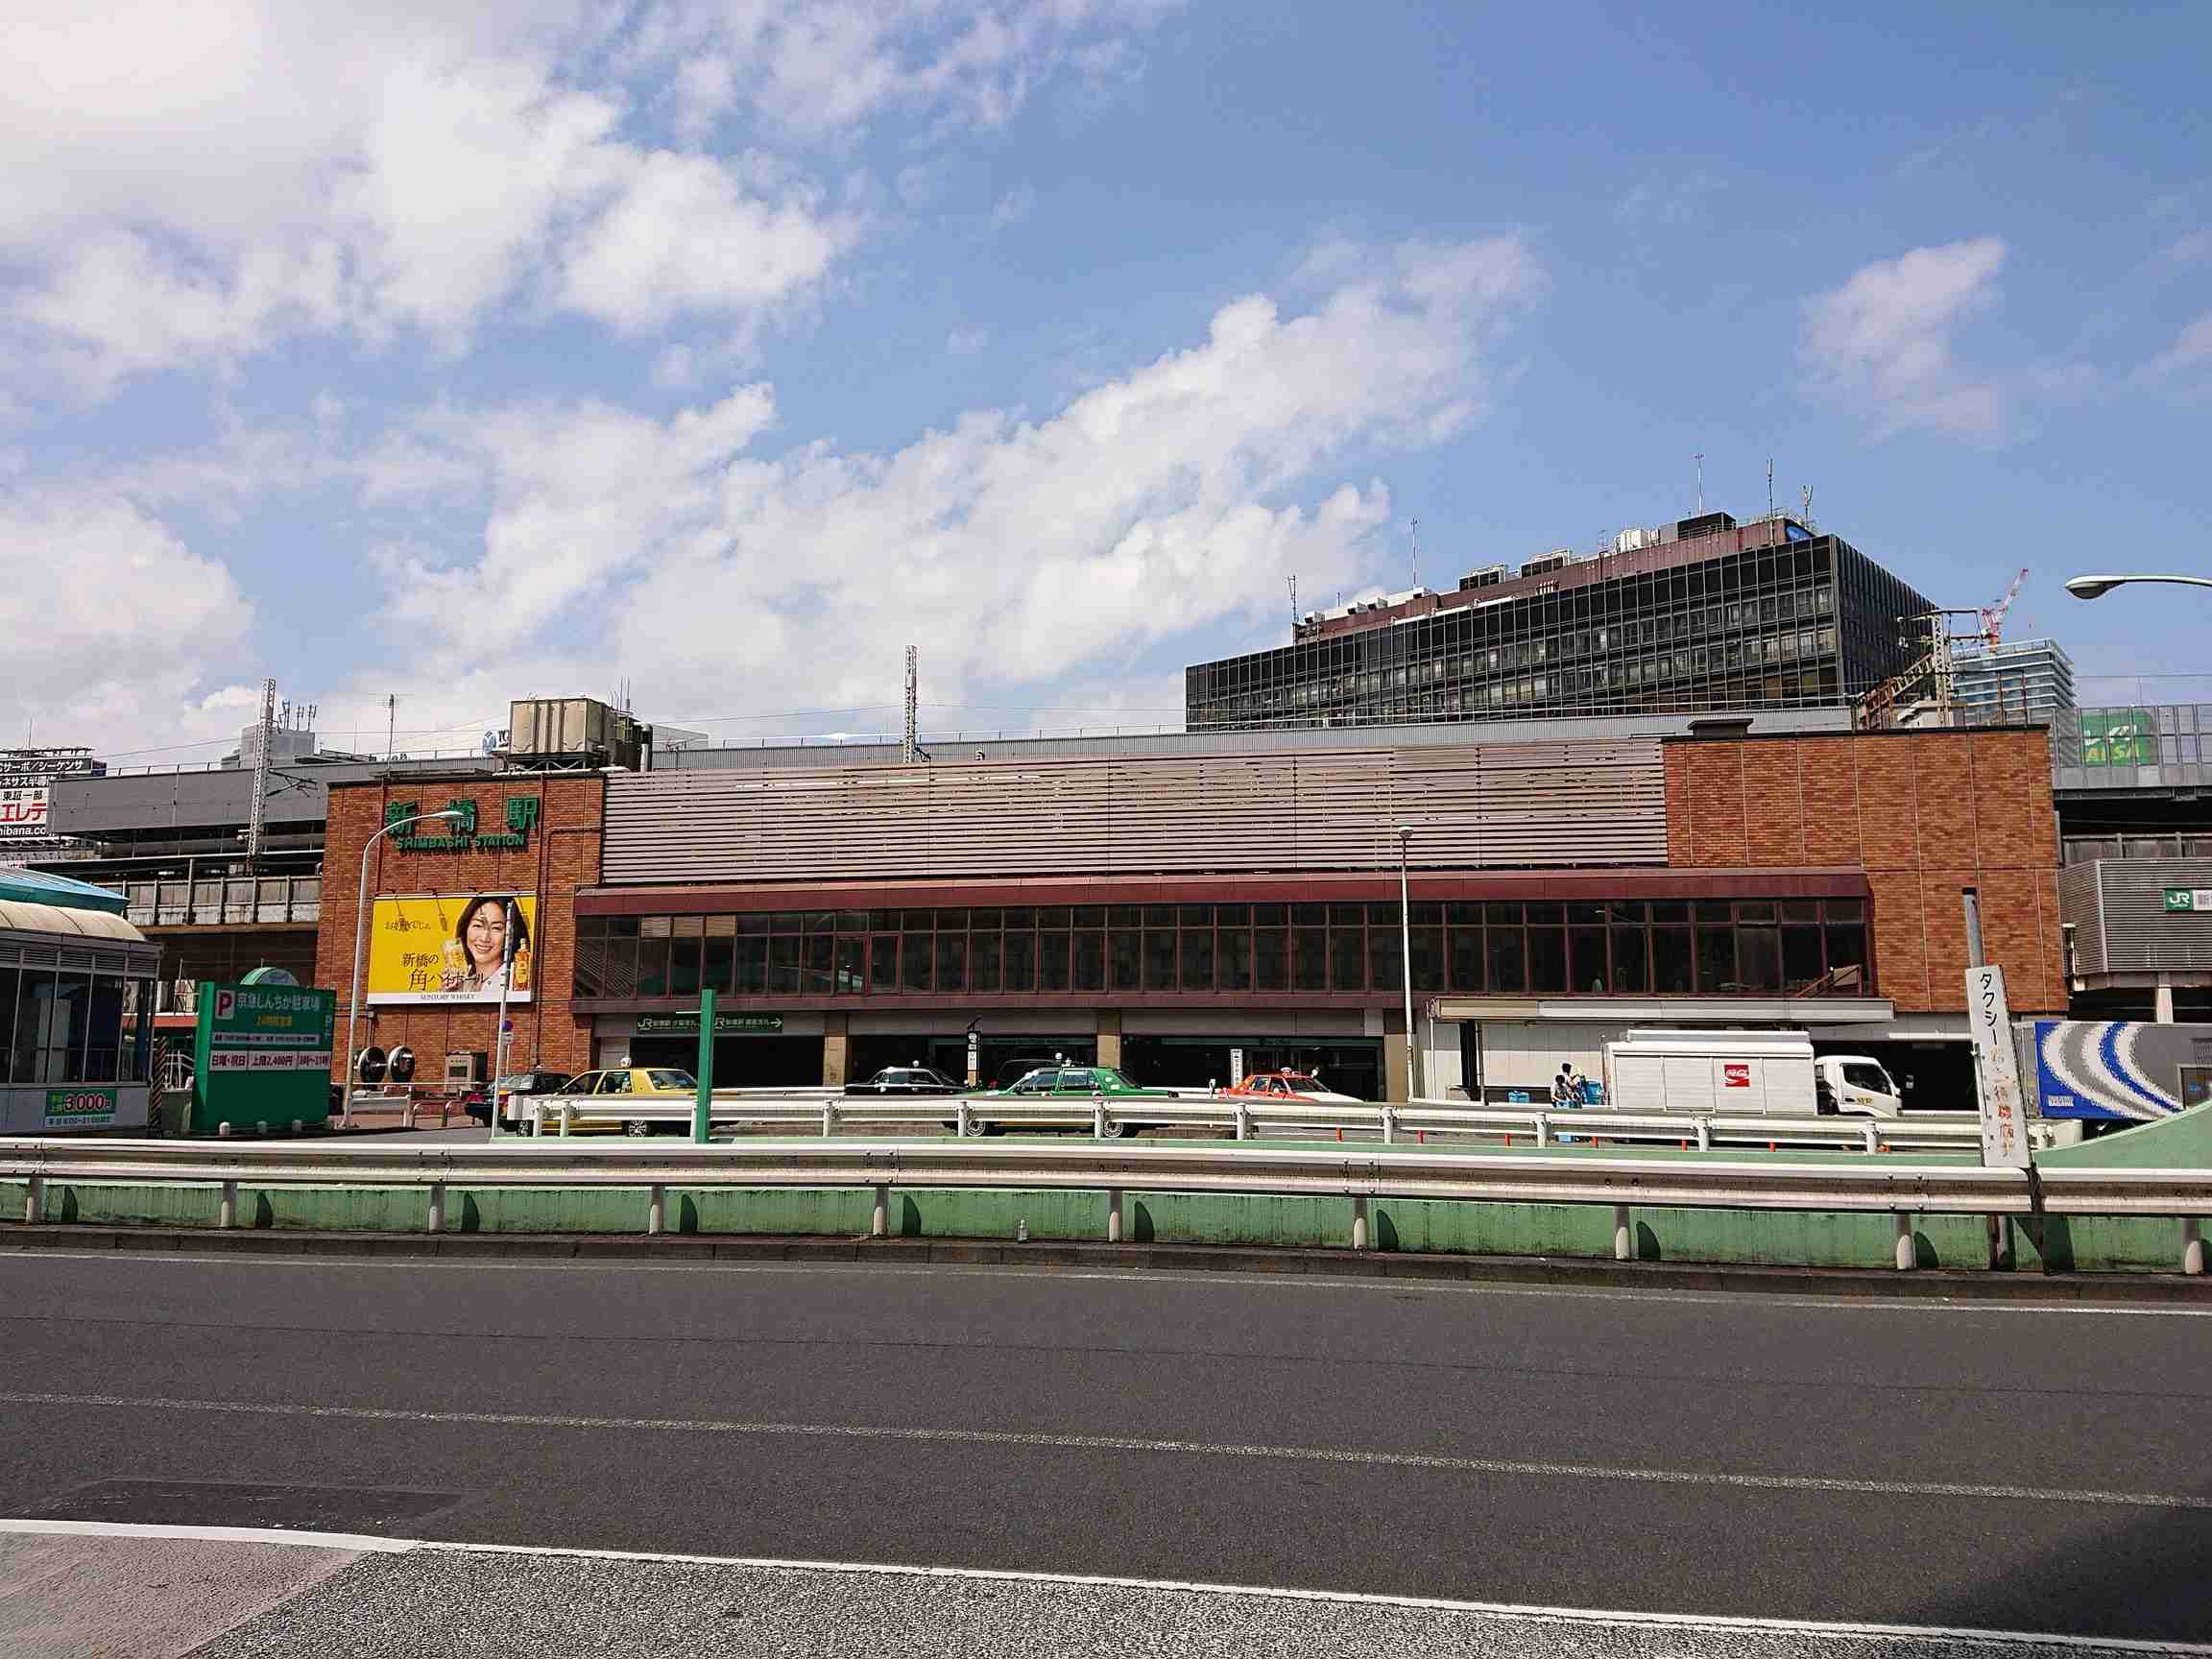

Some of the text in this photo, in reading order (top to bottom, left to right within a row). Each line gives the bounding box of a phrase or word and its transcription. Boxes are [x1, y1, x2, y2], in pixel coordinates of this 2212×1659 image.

[397, 834, 525, 850] SHIMBASHI STATION
[2169, 892, 2190, 904] JR
[401, 952, 439, 968] 新橋の
[218, 992, 232, 1016] P
